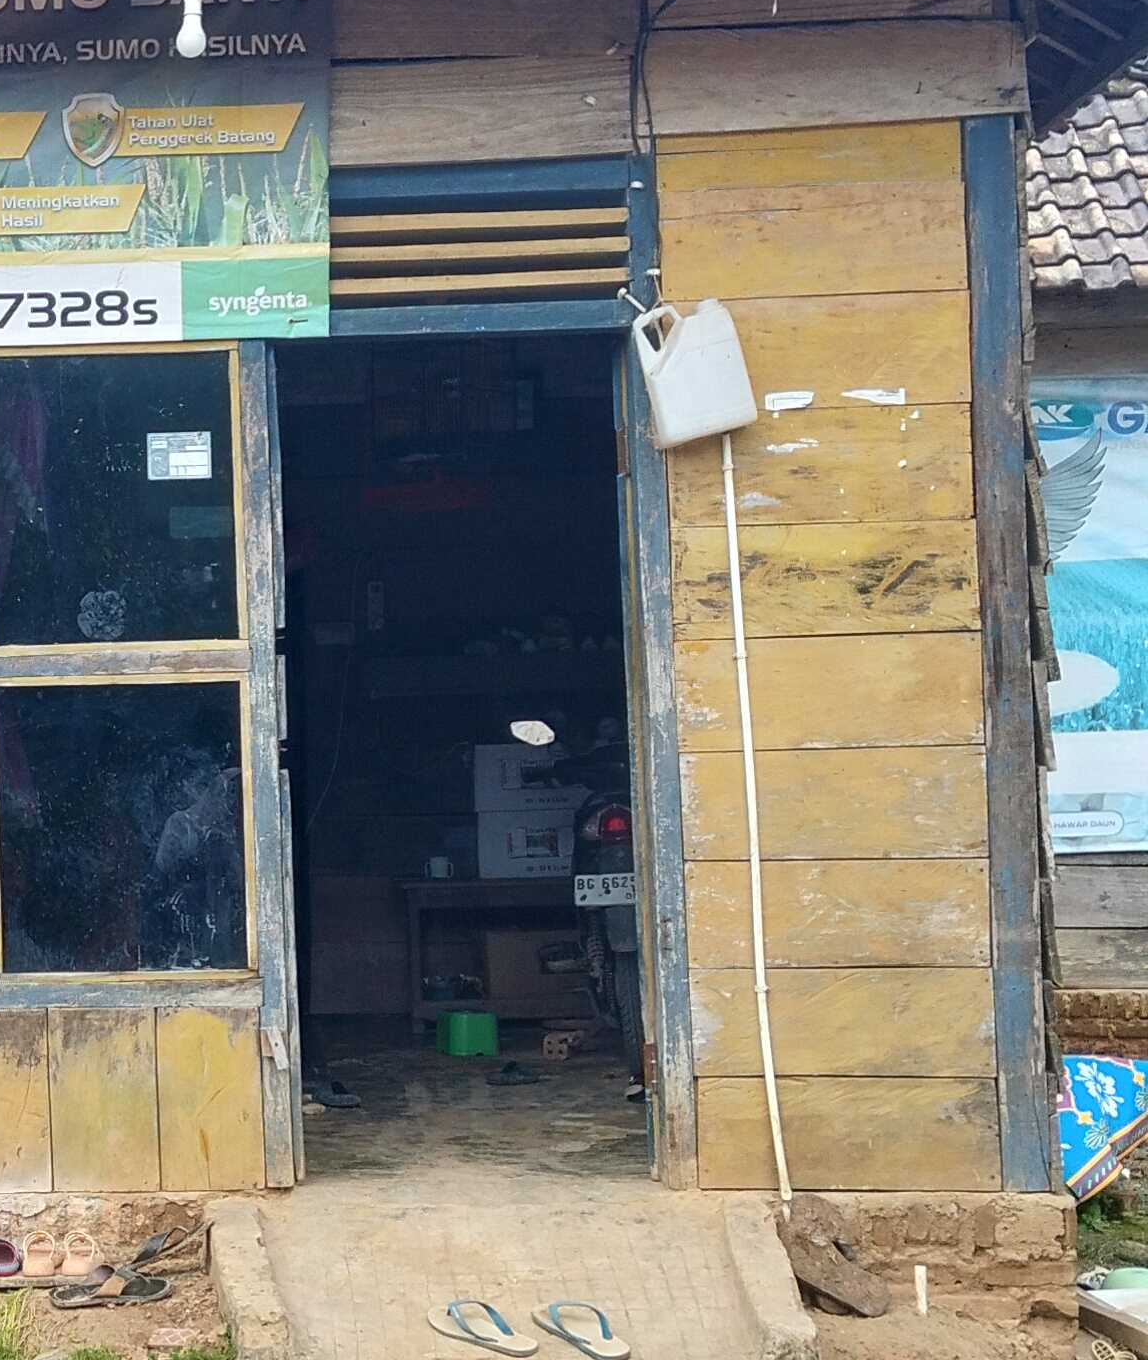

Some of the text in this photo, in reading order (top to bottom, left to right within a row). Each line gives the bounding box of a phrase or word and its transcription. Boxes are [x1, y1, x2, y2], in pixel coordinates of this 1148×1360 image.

[76, 39, 160, 61] SUMO
[169, 33, 306, 57] SILNYA
[129, 114, 214, 129] Tahan Ulat
[129, 130, 276, 147] Penggerek Batang
[2, 194, 120, 211] Meningkatkan
[2, 214, 44, 228] Hasil
[208, 290, 308, 317] syngenta
[576, 878, 595, 891] BG
